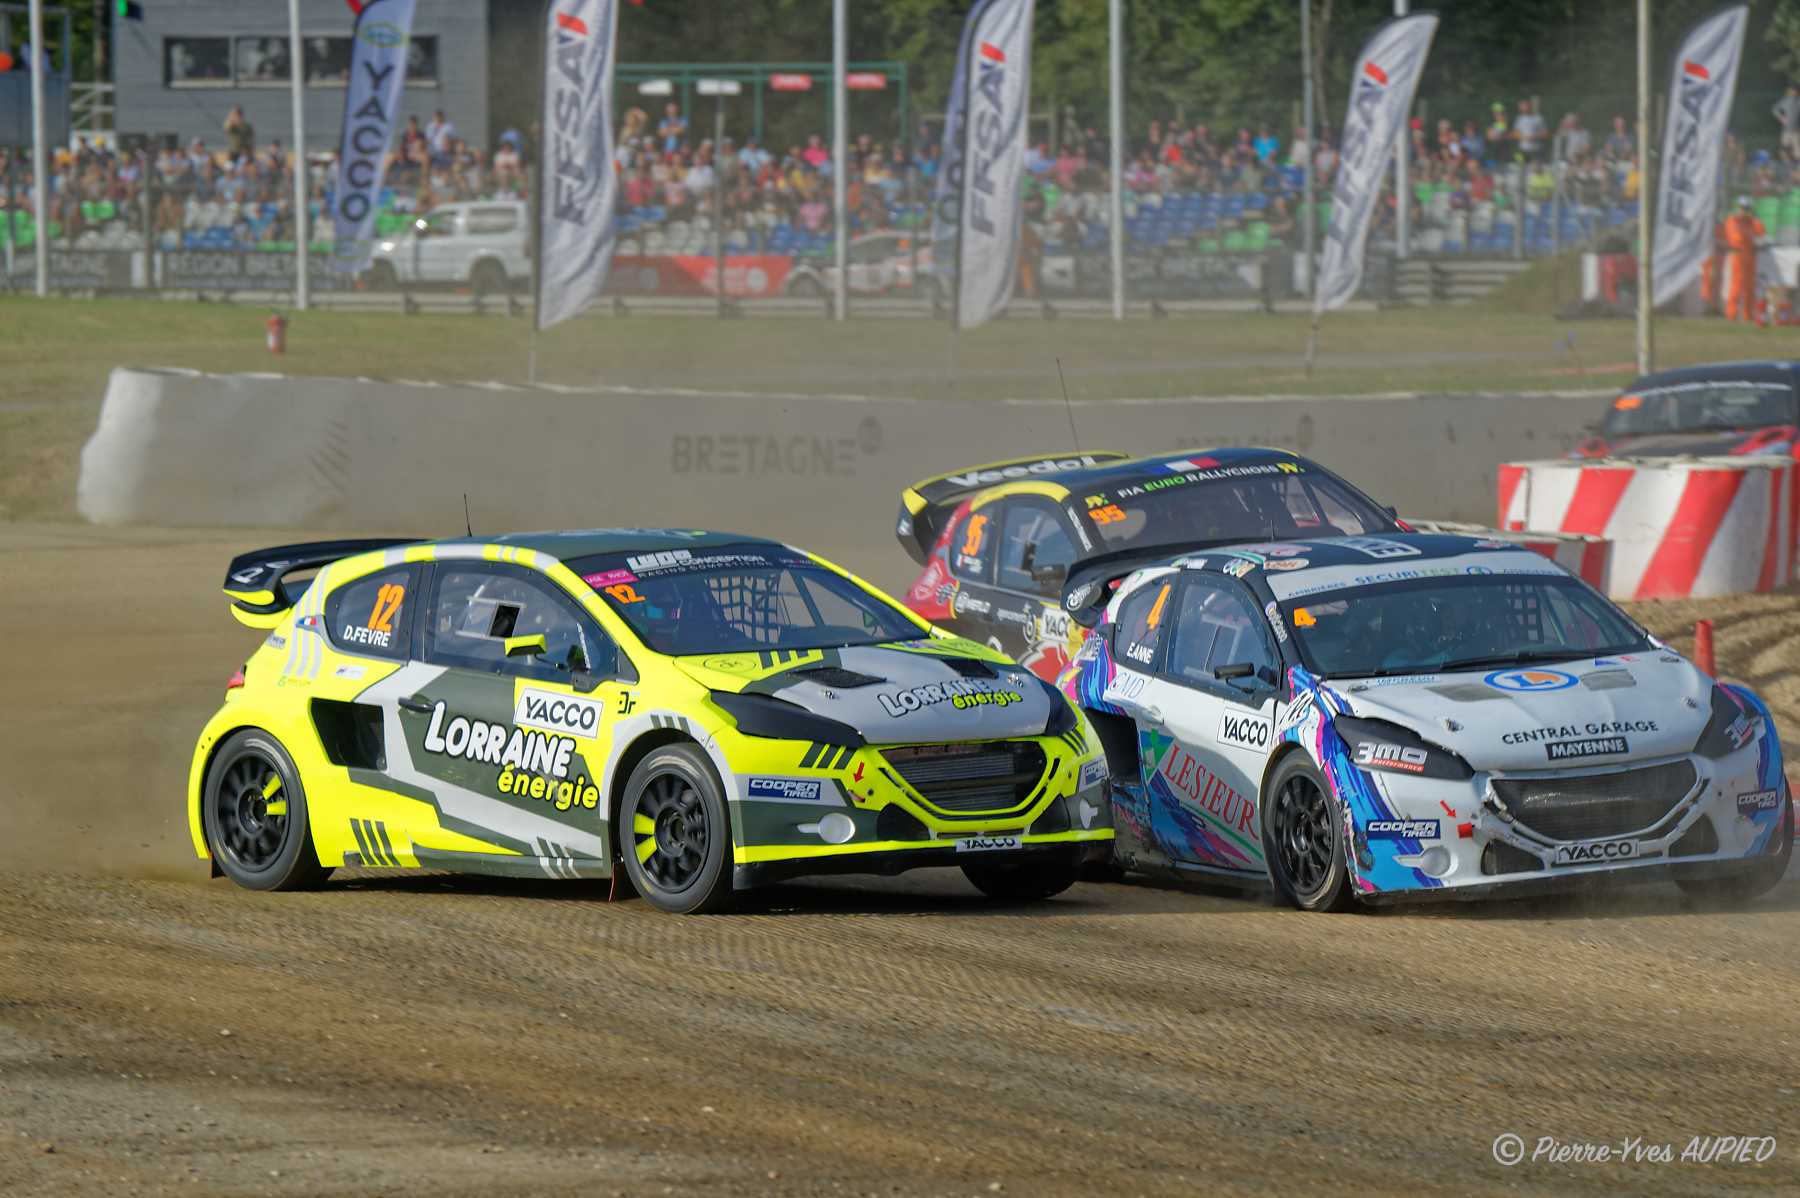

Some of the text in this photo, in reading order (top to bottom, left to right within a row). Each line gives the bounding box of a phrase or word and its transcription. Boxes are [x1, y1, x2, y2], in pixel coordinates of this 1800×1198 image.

[341, 61, 395, 222] YACCO
[670, 433, 857, 476] BRETAGNE
[946, 455, 1096, 487] Veedol
[1144, 476, 1186, 491] EURO
[1186, 464, 1279, 482] RALLYCROSS
[1088, 504, 1127, 525] 95
[605, 583, 646, 604] 12
[368, 583, 406, 632] 12
[1147, 584, 1172, 630] 4
[1293, 607, 1317, 628] 4
[343, 625, 392, 648] D.FEVRE
[877, 677, 993, 718] LORRAINE
[526, 696, 597, 731] YACCO
[424, 700, 577, 778] LORRAINE
[1224, 716, 1268, 747] YACCO
[1502, 720, 1659, 745] CENTRAL GARAGE
[1551, 738, 1626, 758] MAYENNE
[497, 764, 600, 811] énergie
[751, 779, 820, 793] COOPER
[783, 790, 817, 799] TIRES
[1164, 744, 1260, 841] LESIEUR
[1368, 821, 1439, 833] COOPER
[1400, 829, 1436, 838] TIRES
[963, 837, 1016, 849] YACCO
[1560, 841, 1633, 861] YACCO
